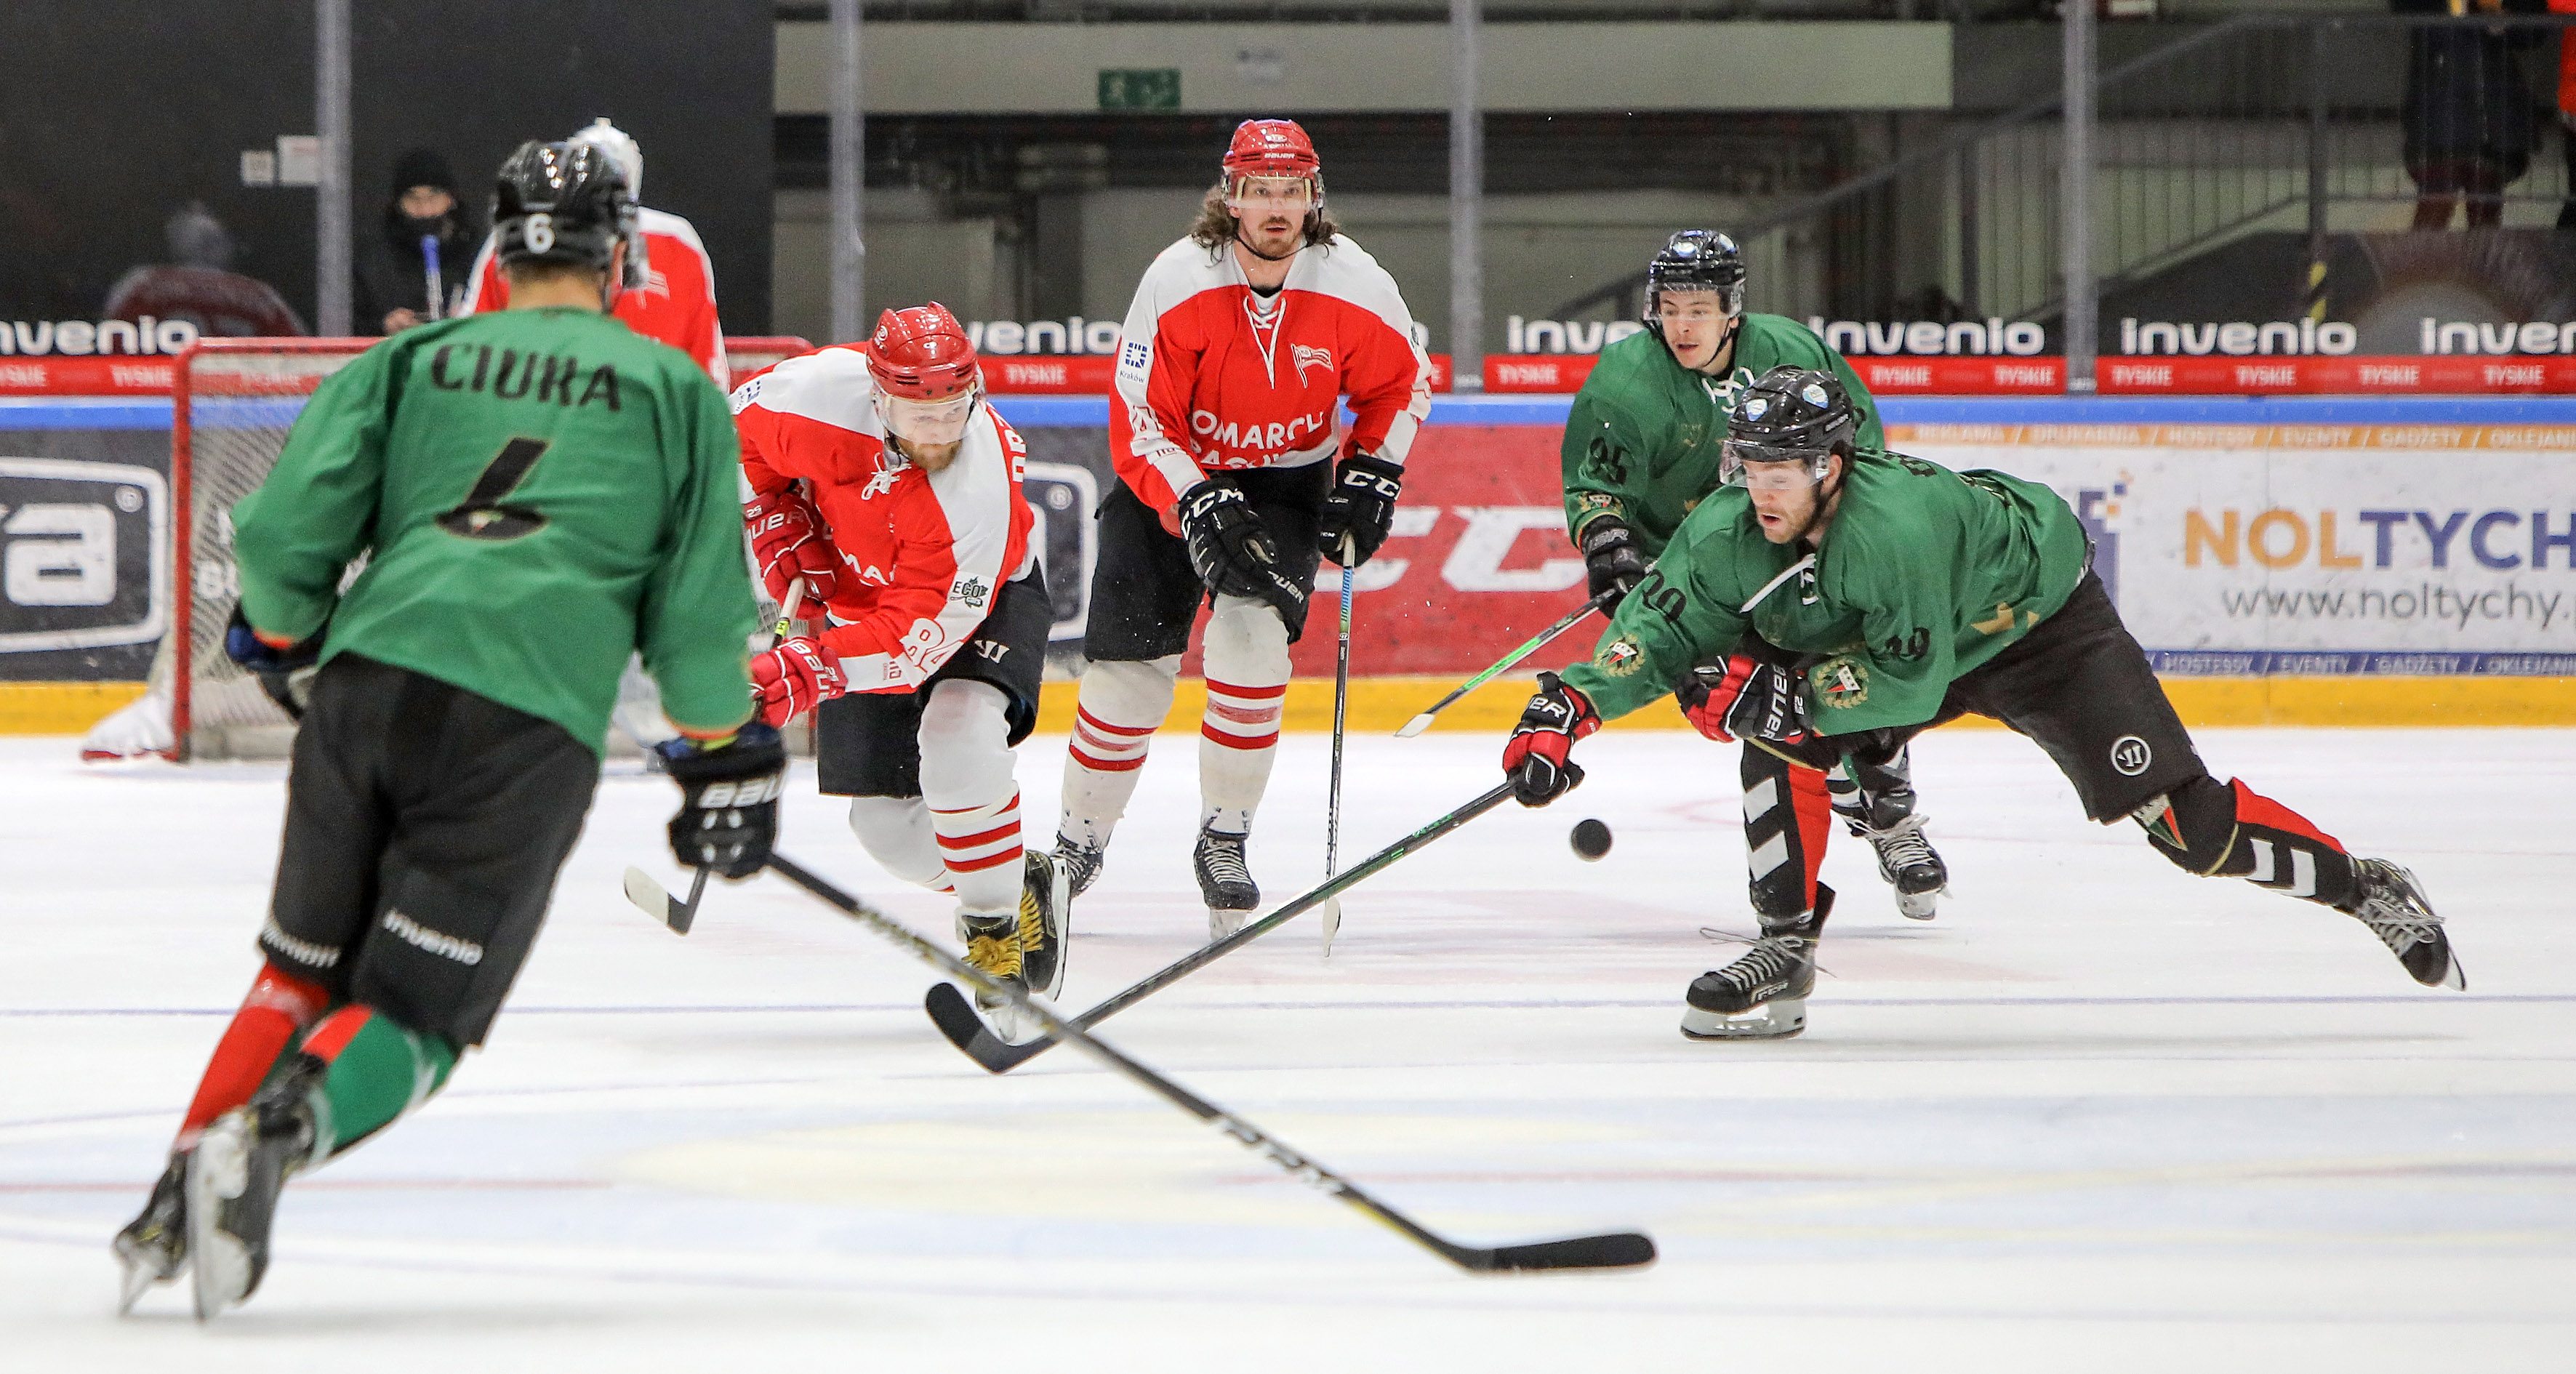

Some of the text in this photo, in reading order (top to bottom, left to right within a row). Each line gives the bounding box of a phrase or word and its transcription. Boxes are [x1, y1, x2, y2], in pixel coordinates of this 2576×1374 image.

[523, 212, 555, 254] 6
[2120, 317, 2357, 355] invenio
[1006, 363, 1067, 385] TYSKIE
[1119, 369, 1145, 384] Kraków
[2111, 364, 2173, 387] TYSKIE
[2235, 365, 2297, 387] TYSKIE
[2358, 364, 2421, 386] TYSKIE
[2483, 365, 2545, 386] TYSKIE
[435, 436, 551, 541] 6
[1344, 469, 1402, 501] CC
[899, 617, 964, 677] 84
